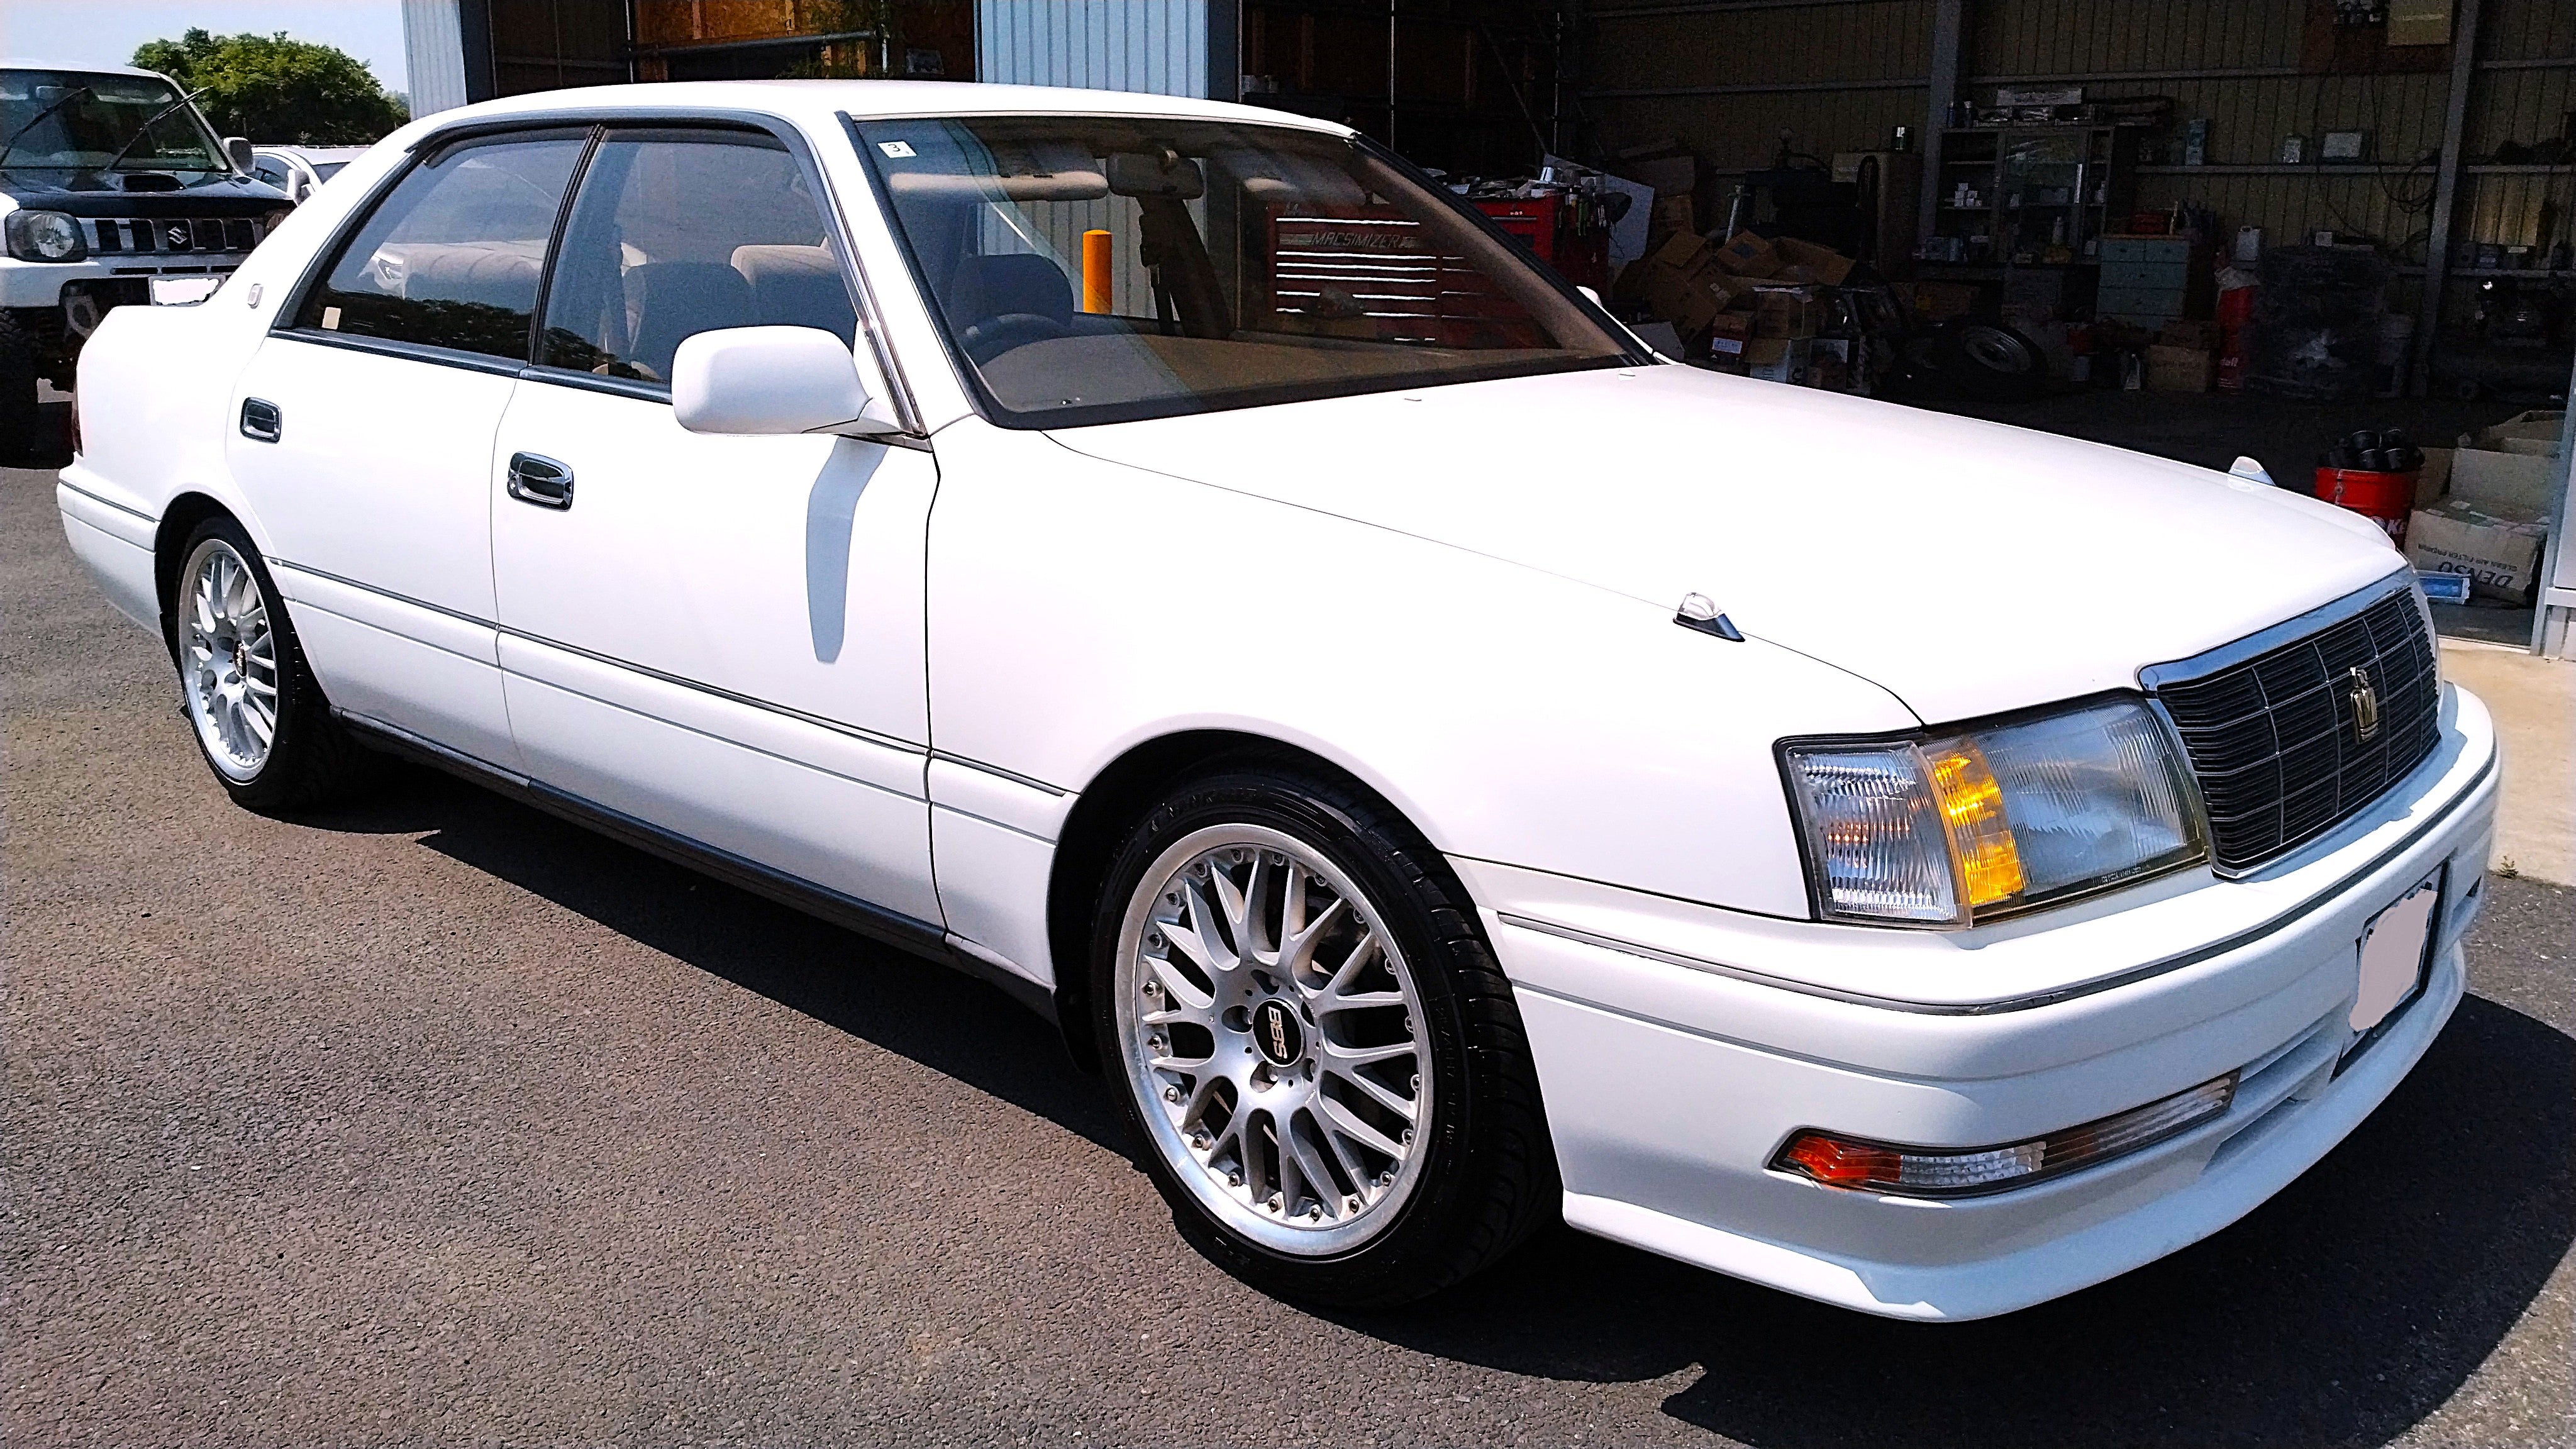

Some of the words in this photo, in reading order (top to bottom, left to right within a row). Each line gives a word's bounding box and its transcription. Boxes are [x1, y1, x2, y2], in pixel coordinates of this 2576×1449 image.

[888, 143, 900, 152] 3
[1311, 232, 1402, 248] MACSIMIZER
[2438, 562, 2513, 588] DENSO
[1267, 1006, 1288, 1060] BBS
